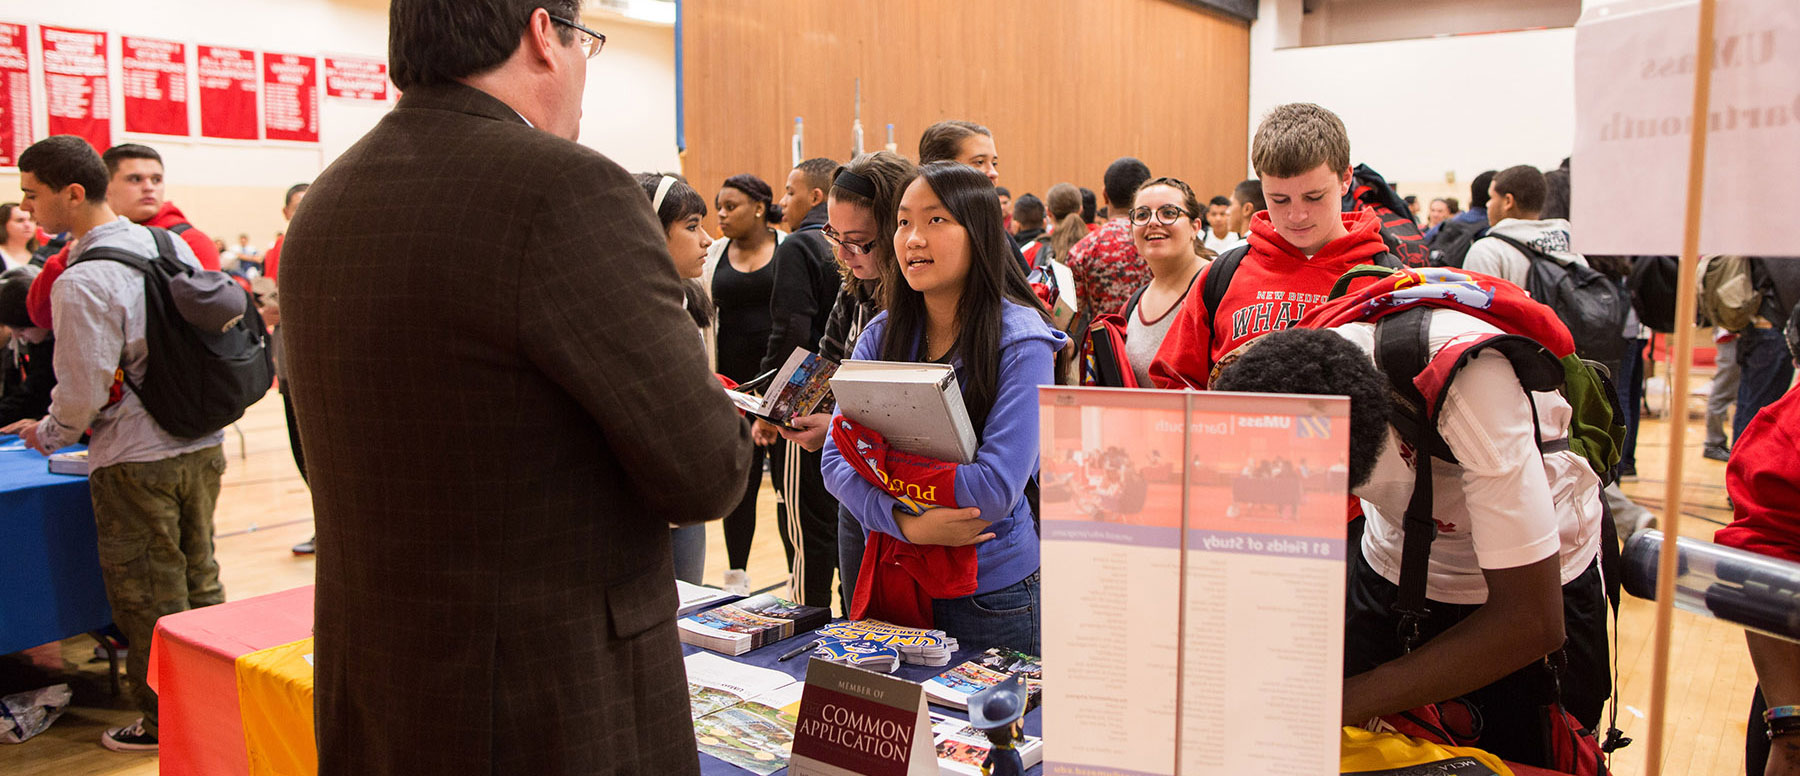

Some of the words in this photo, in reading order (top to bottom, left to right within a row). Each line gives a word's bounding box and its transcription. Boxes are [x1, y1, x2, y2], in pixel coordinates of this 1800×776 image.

[1527, 236, 1565, 248] NORTH
[1256, 290, 1285, 300] NEW
[815, 627, 936, 647] UMASS
[838, 680, 872, 697] MEMBER
[873, 688, 885, 700] OF
[822, 703, 912, 745] COMMON
[799, 718, 908, 763] APPLICATION
[1437, 760, 1477, 771] MCLA
